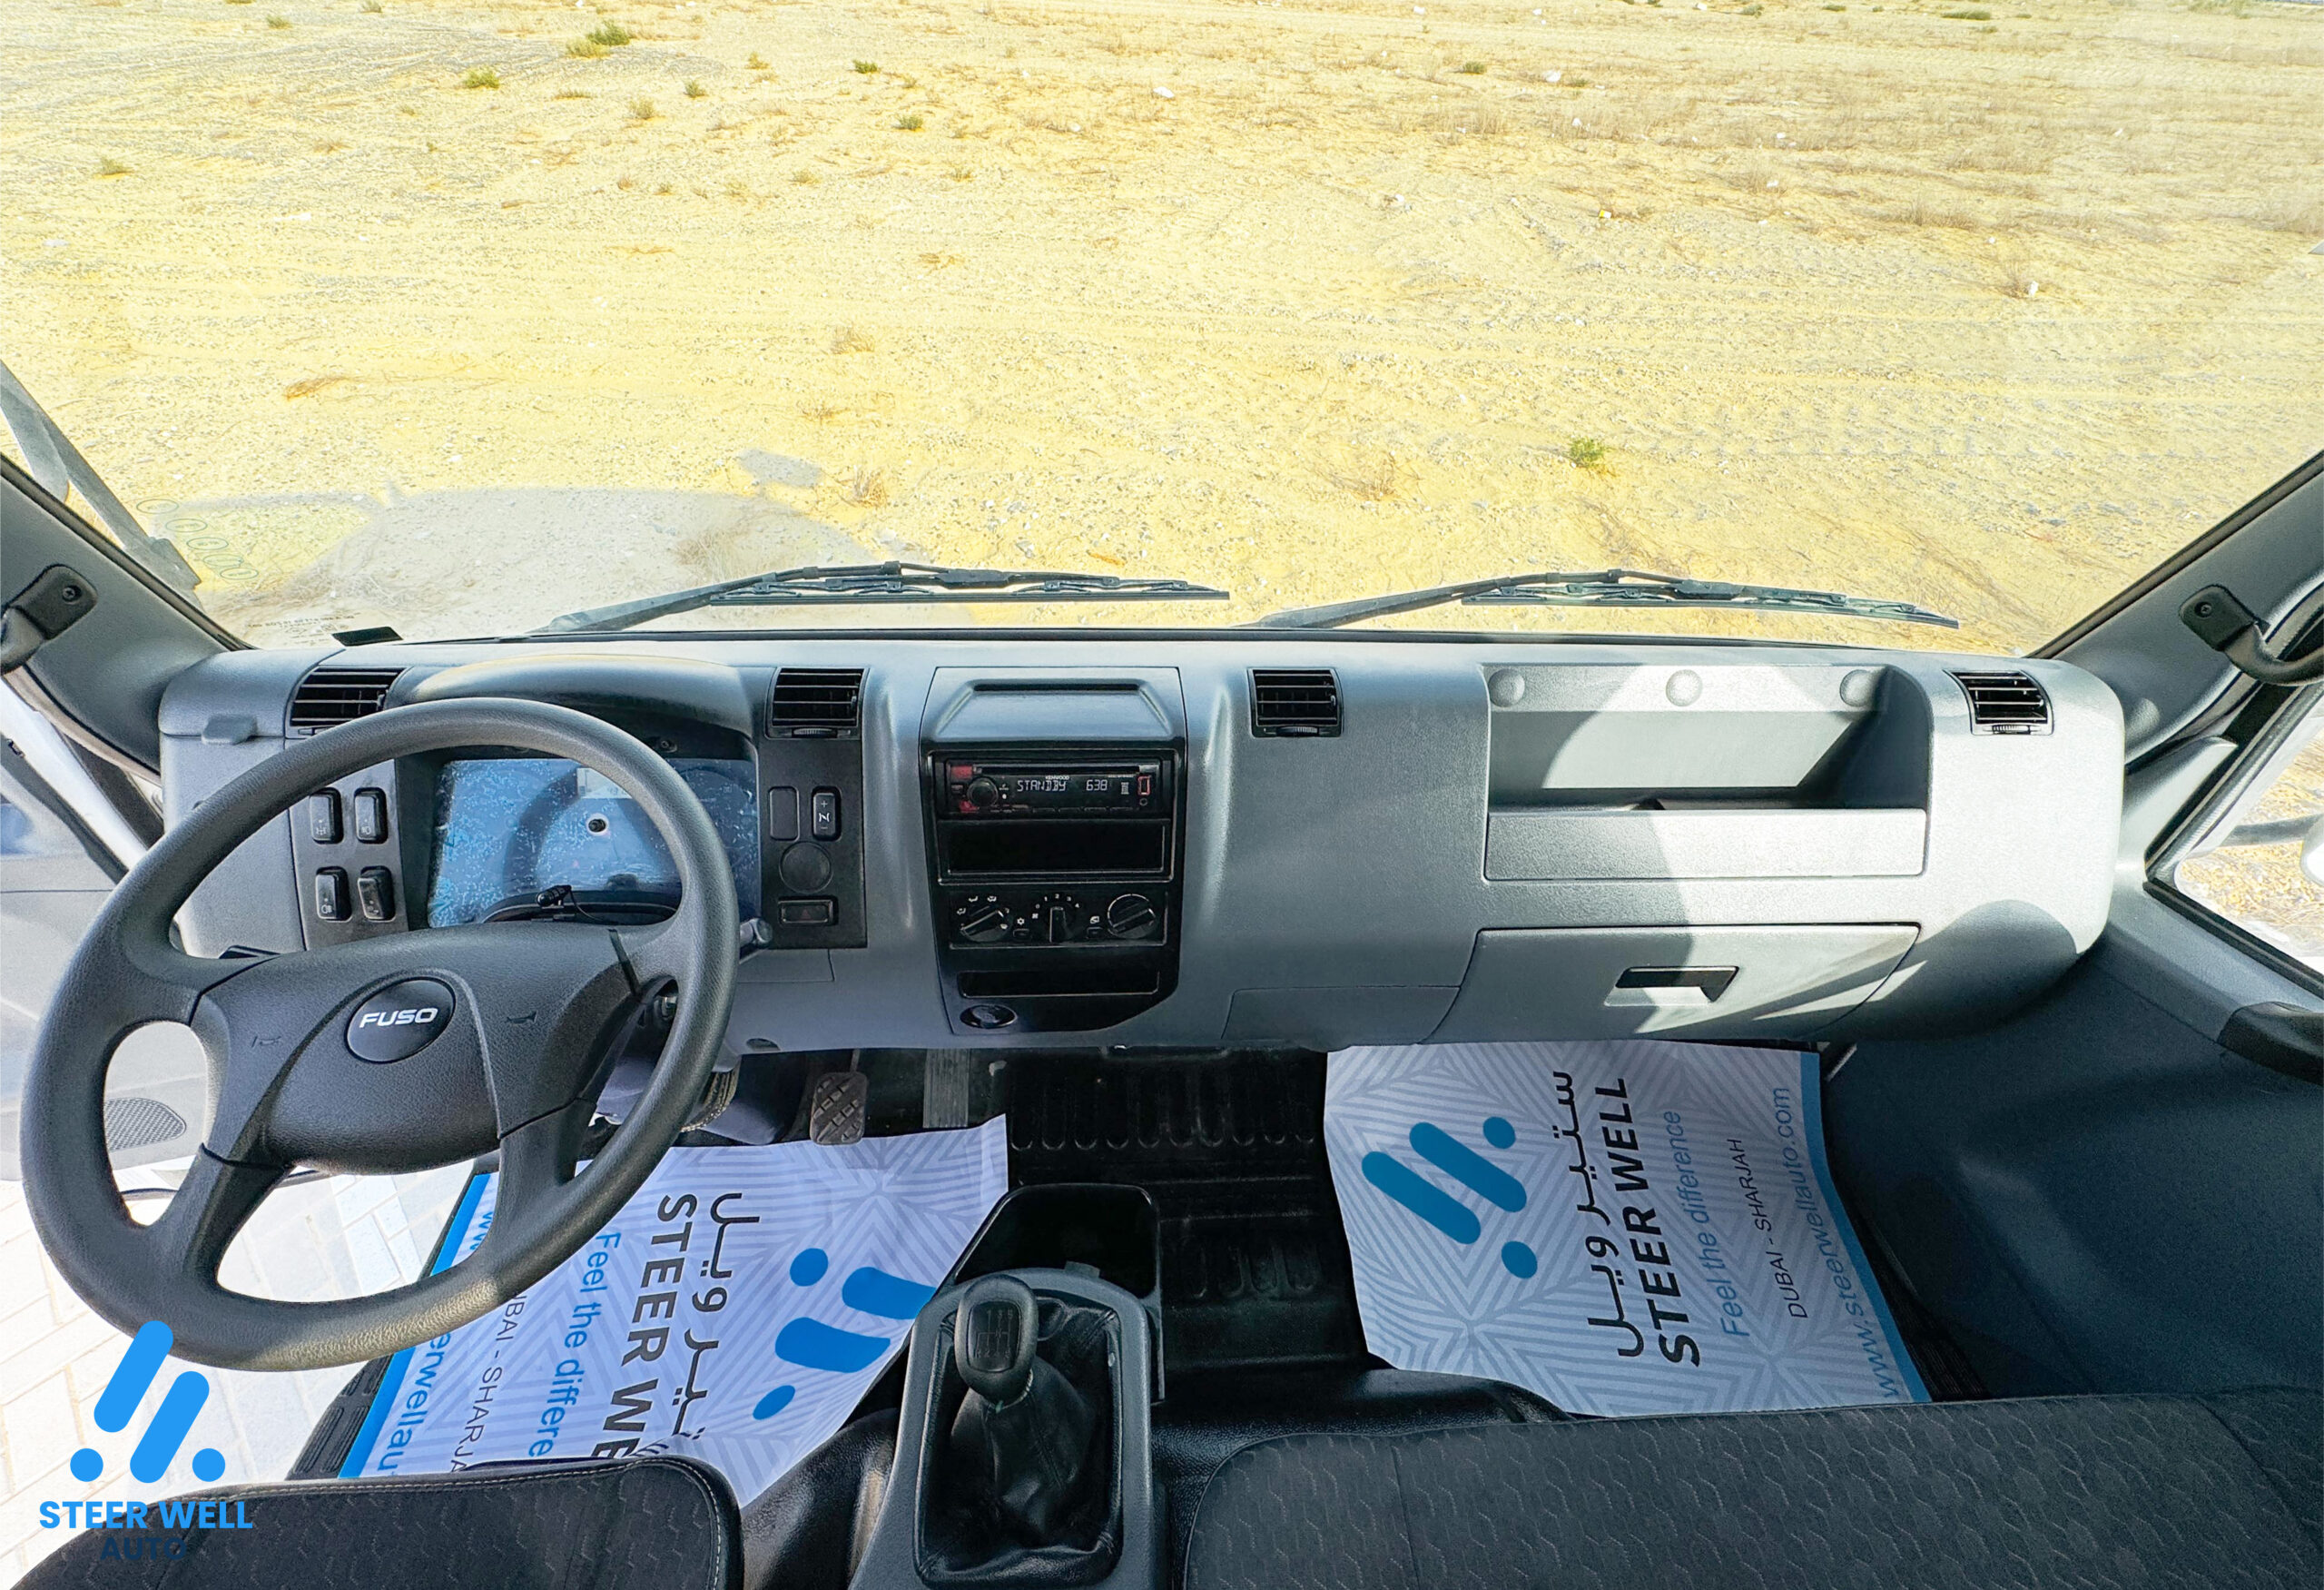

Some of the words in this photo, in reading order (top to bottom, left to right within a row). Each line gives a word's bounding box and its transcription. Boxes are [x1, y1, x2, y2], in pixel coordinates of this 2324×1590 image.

[1017, 779, 1067, 792] STANDBY
[1086, 779, 1108, 791] 638
[359, 1007, 438, 1029] FUSO
[1594, 1078, 1649, 1191] WELL
[1663, 1111, 1710, 1224] difference
[1552, 1071, 1611, 1226] ستير
[1584, 1236, 1644, 1357] ويل
[1726, 1138, 1772, 1231] SHARJAH
[579, 1231, 622, 1293] Feel
[621, 1193, 697, 1367] STEER
[1698, 1231, 1725, 1270] the
[1773, 1088, 1900, 1398] www.steerwellauto.com
[1621, 1205, 1700, 1368] STEER
[1706, 1279, 1750, 1337] Feel
[1765, 1250, 1809, 1318] DUBAI
[564, 1301, 602, 1348] the
